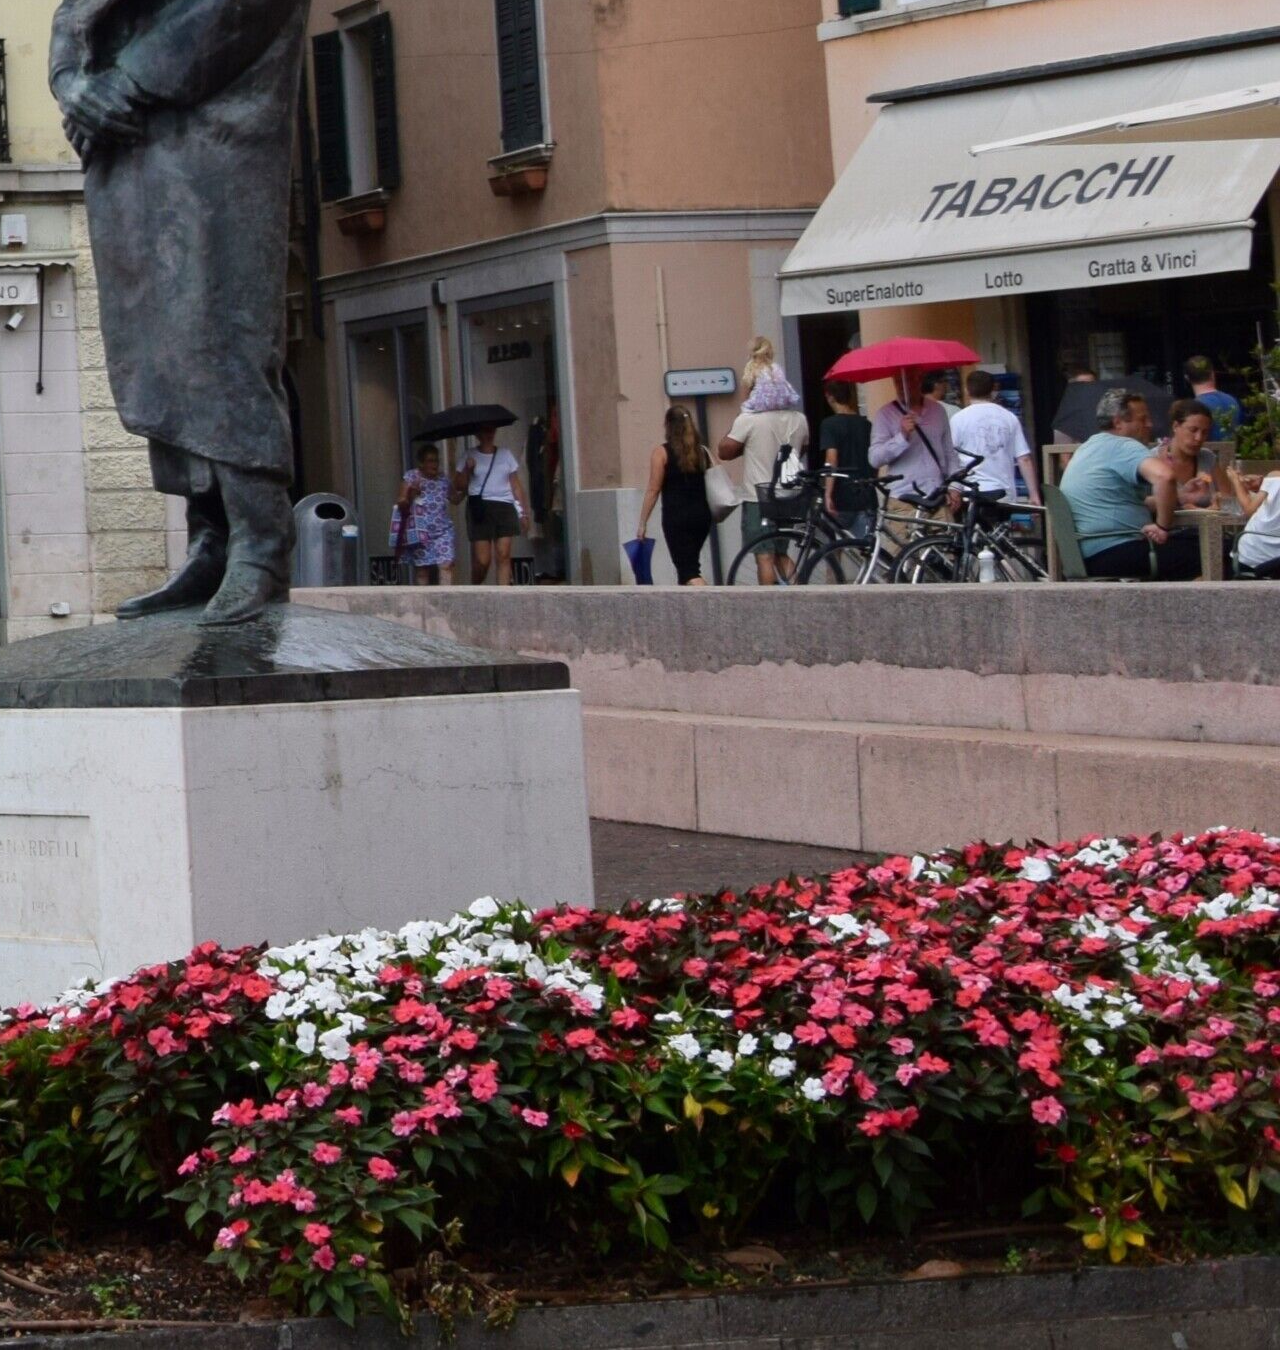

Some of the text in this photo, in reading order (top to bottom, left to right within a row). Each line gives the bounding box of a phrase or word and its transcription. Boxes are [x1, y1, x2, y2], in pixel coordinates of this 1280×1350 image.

[920, 154, 1175, 223] TABACCHI
[826, 249, 1197, 307] SuperEnalotto Lotto Gratta & Vinci
[56, 304, 64, 314] 3
